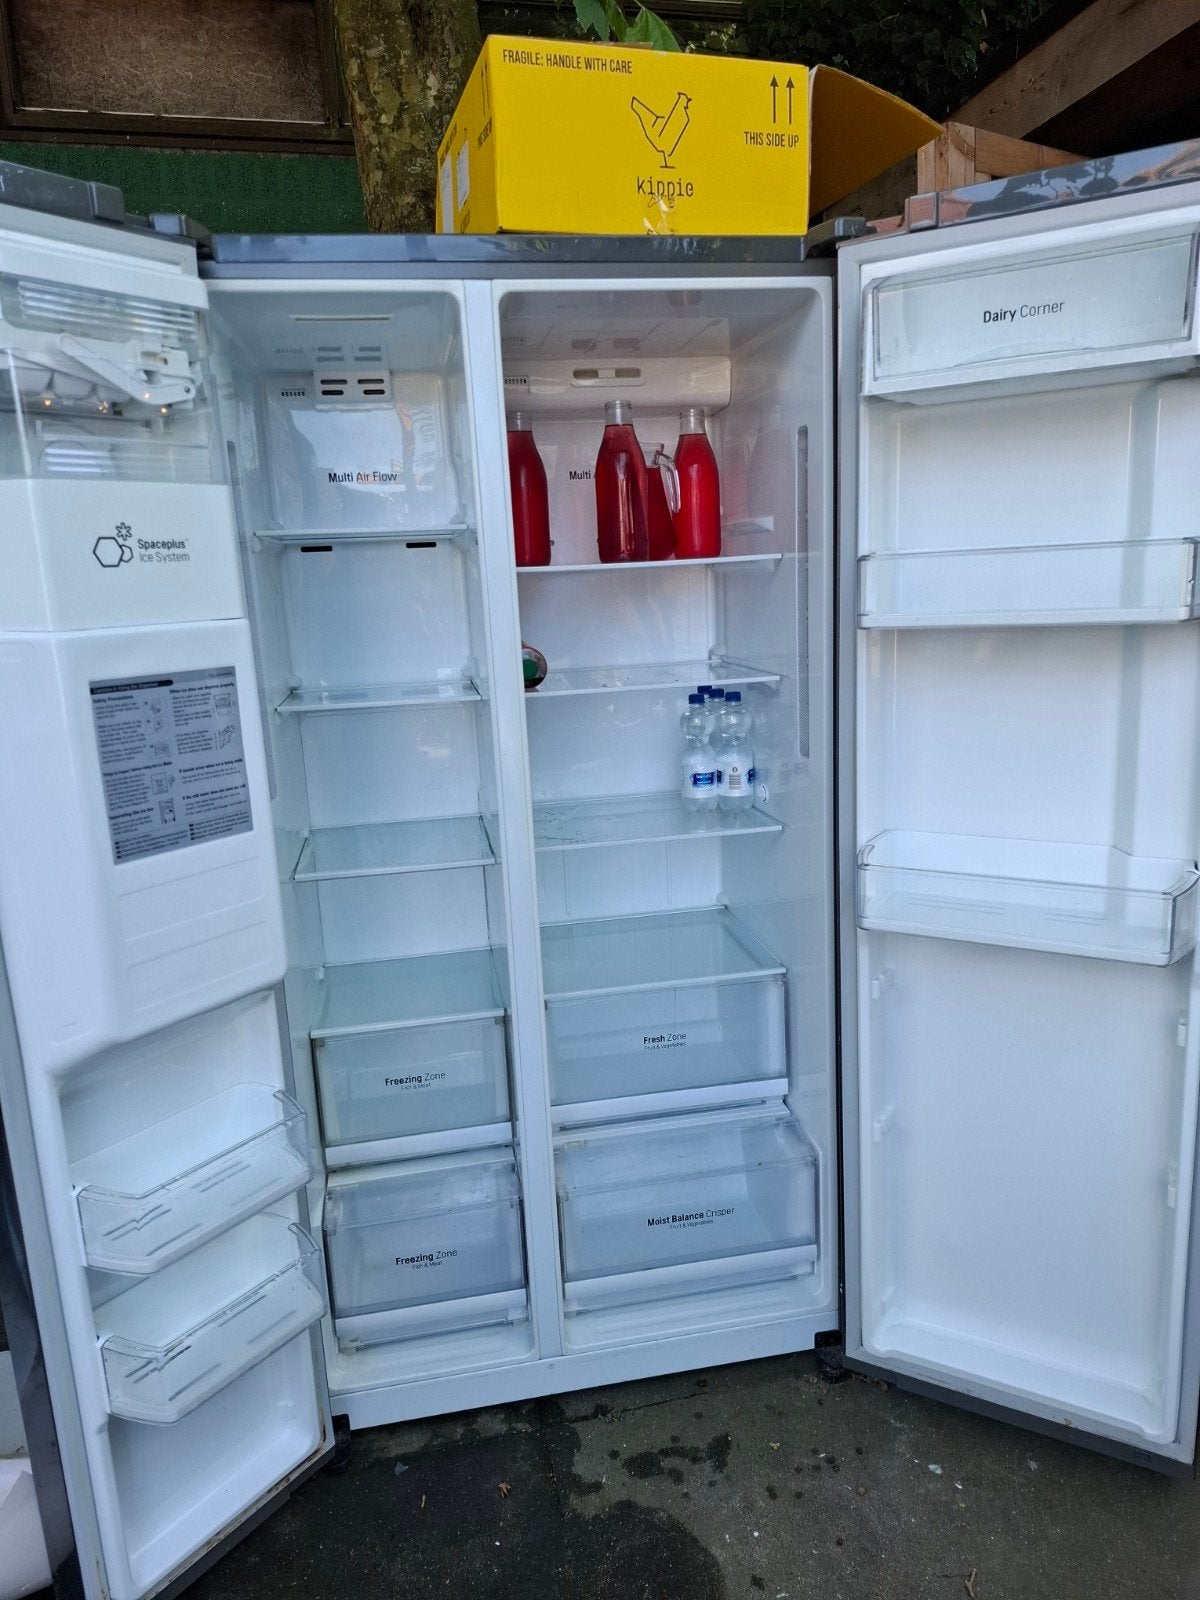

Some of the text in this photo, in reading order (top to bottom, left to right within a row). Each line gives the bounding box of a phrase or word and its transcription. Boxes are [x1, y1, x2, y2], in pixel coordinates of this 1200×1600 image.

[502, 49, 632, 74] FRAGILE: HANDLE WITH CARE
[744, 131, 800, 148] THIS SIDE UP
[637, 176, 694, 201] kippie
[983, 301, 1065, 322] Dairy Corner
[328, 472, 397, 483] Multi Air Flow
[569, 470, 591, 480] Multi
[139, 552, 190, 564] Ice System
[643, 1033, 687, 1044] Fresh Zone
[385, 1072, 446, 1086] Freezing Zone
[647, 1208, 735, 1226] Moist Balance Crisper
[395, 1249, 458, 1265] Freezing Zone
